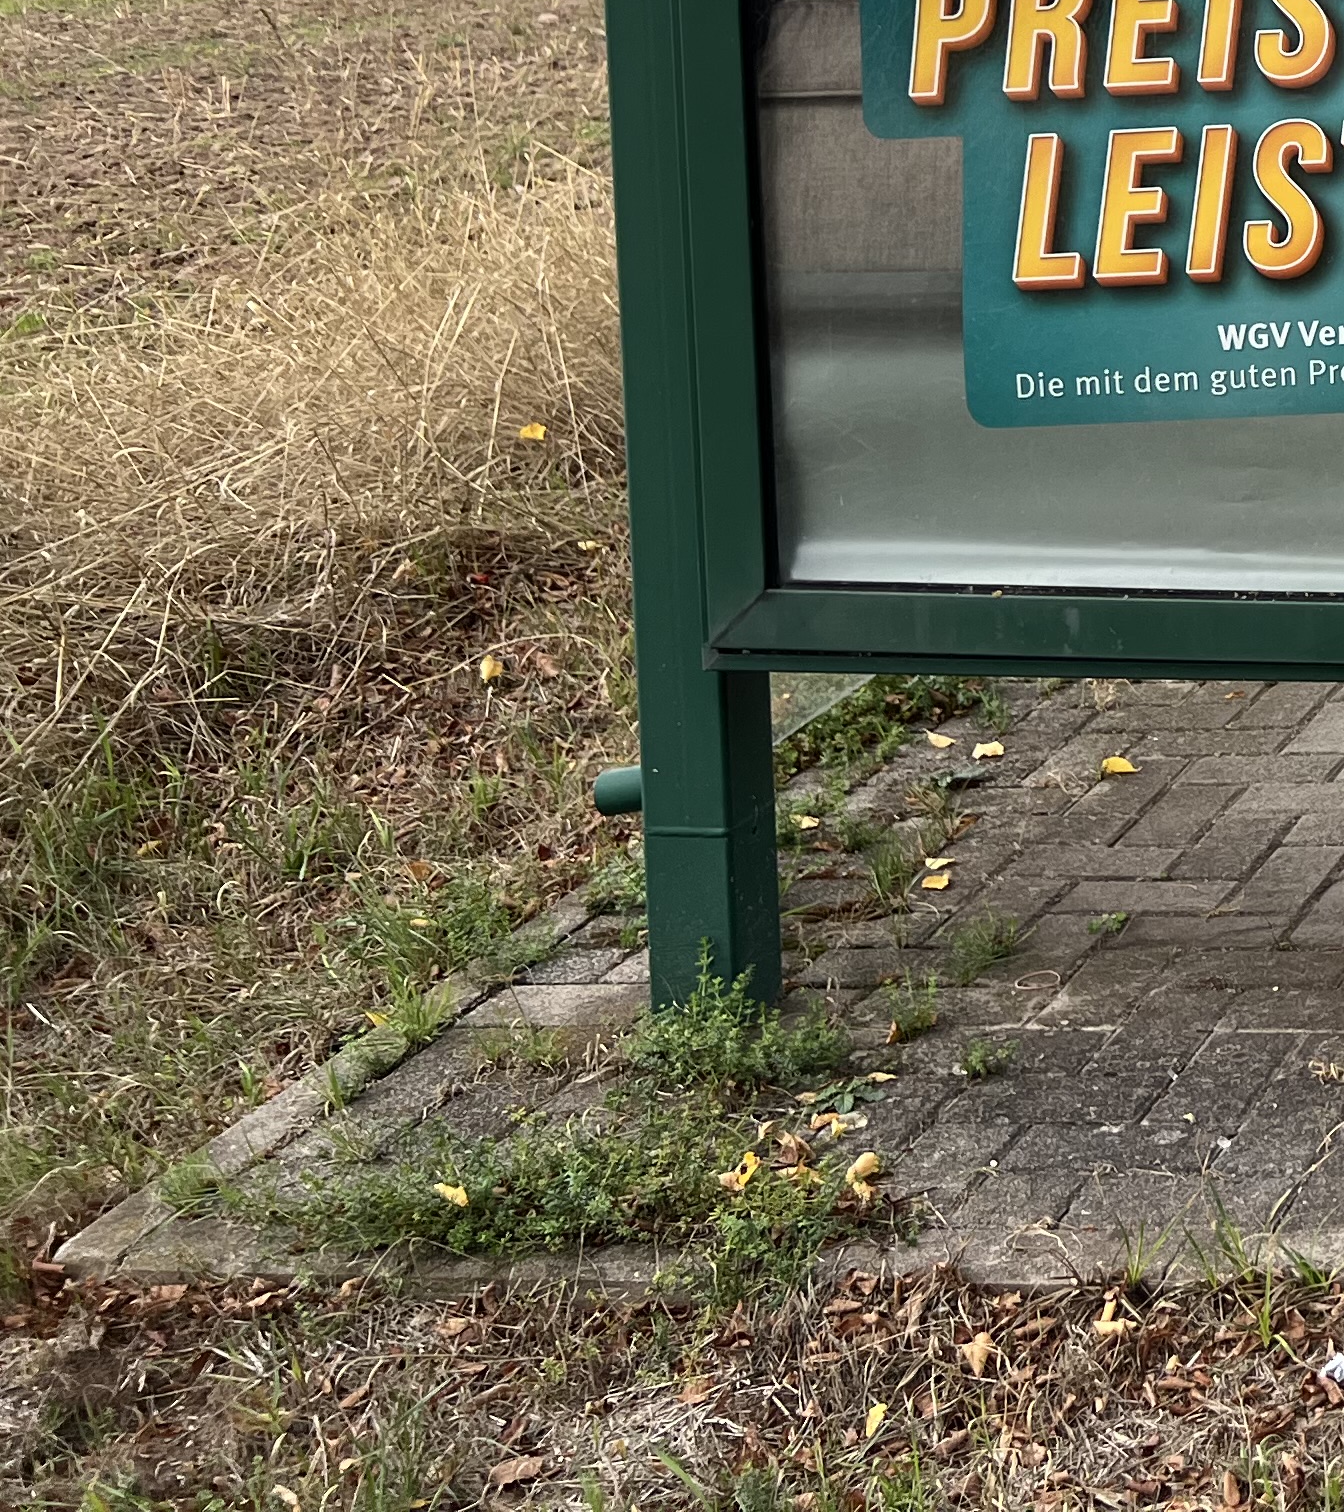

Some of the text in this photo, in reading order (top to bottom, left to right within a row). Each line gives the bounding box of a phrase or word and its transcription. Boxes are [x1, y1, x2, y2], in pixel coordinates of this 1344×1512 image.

[1216, 320, 1292, 351] WGV
[1015, 371, 1065, 399] Die
[1076, 368, 1125, 396] mit
[1134, 366, 1199, 393] dem
[1210, 363, 1297, 396] guten
